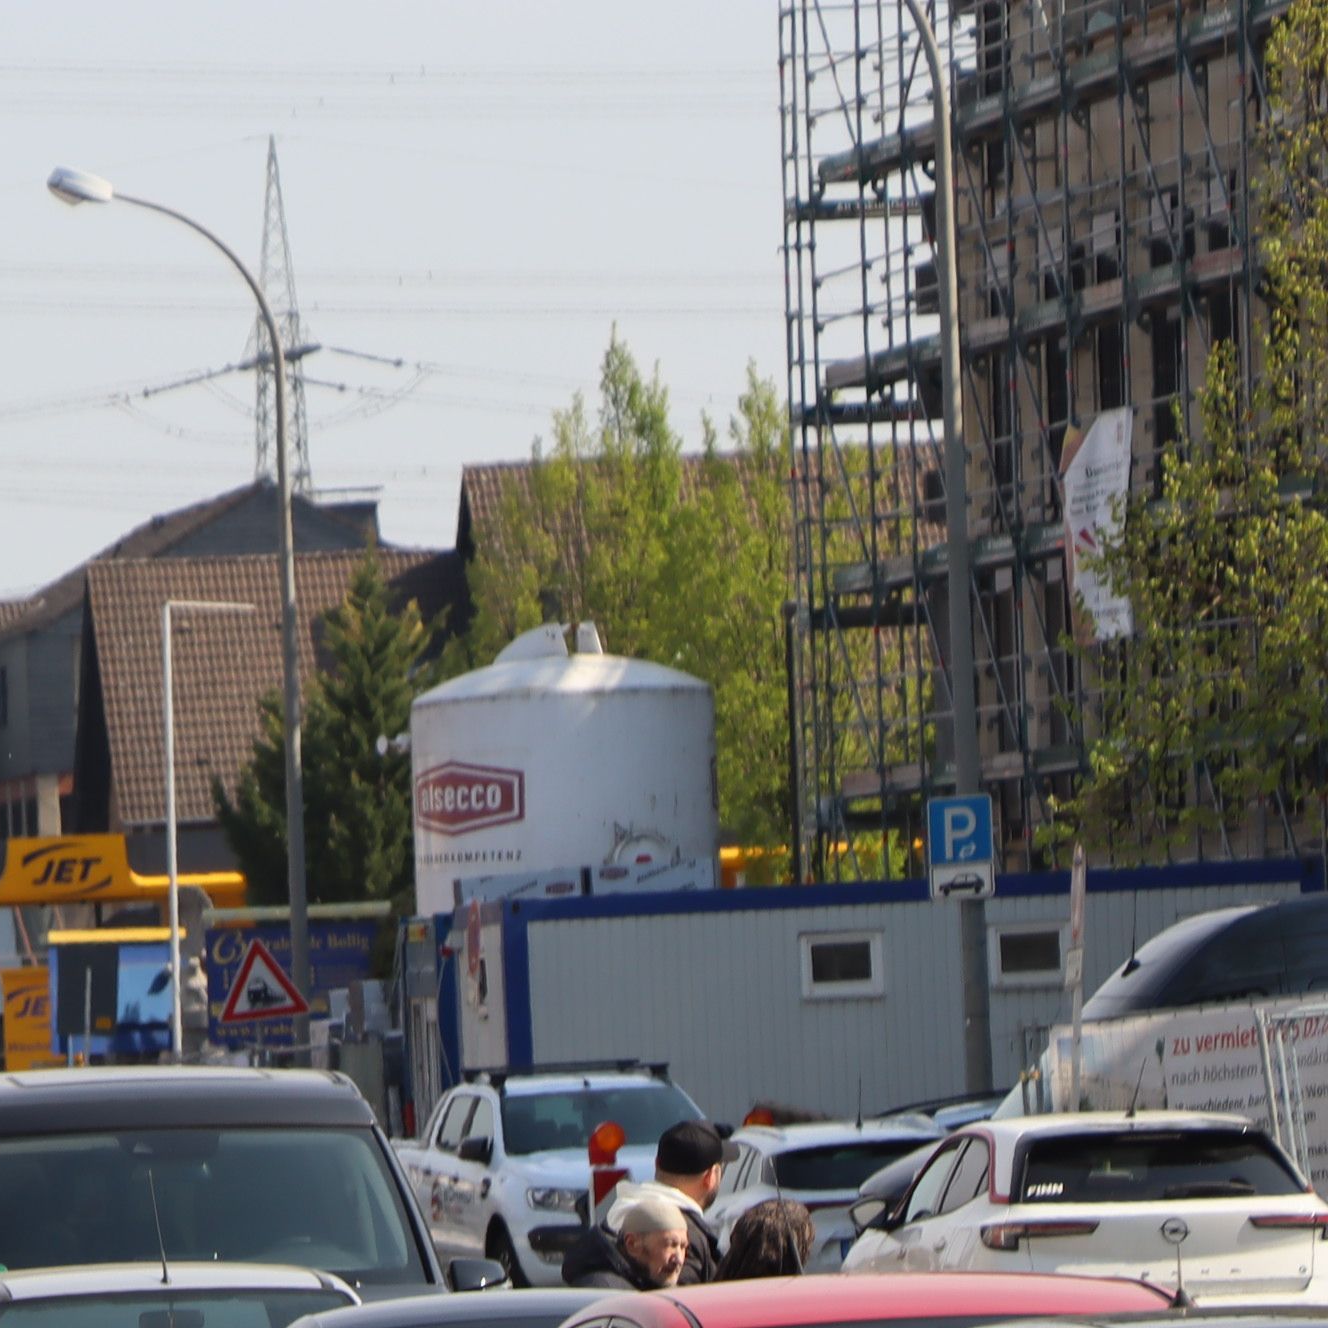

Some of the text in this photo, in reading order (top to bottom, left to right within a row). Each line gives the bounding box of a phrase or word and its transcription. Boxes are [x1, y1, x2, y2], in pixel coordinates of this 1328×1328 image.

[421, 783, 502, 812] alsecco
[944, 806, 976, 859] P
[32, 856, 102, 886] JET
[16, 995, 49, 1018] JE
[1173, 1037, 1191, 1055] zu
[1196, 1023, 1276, 1055] vermietn
[1172, 1065, 1201, 1086] nach
